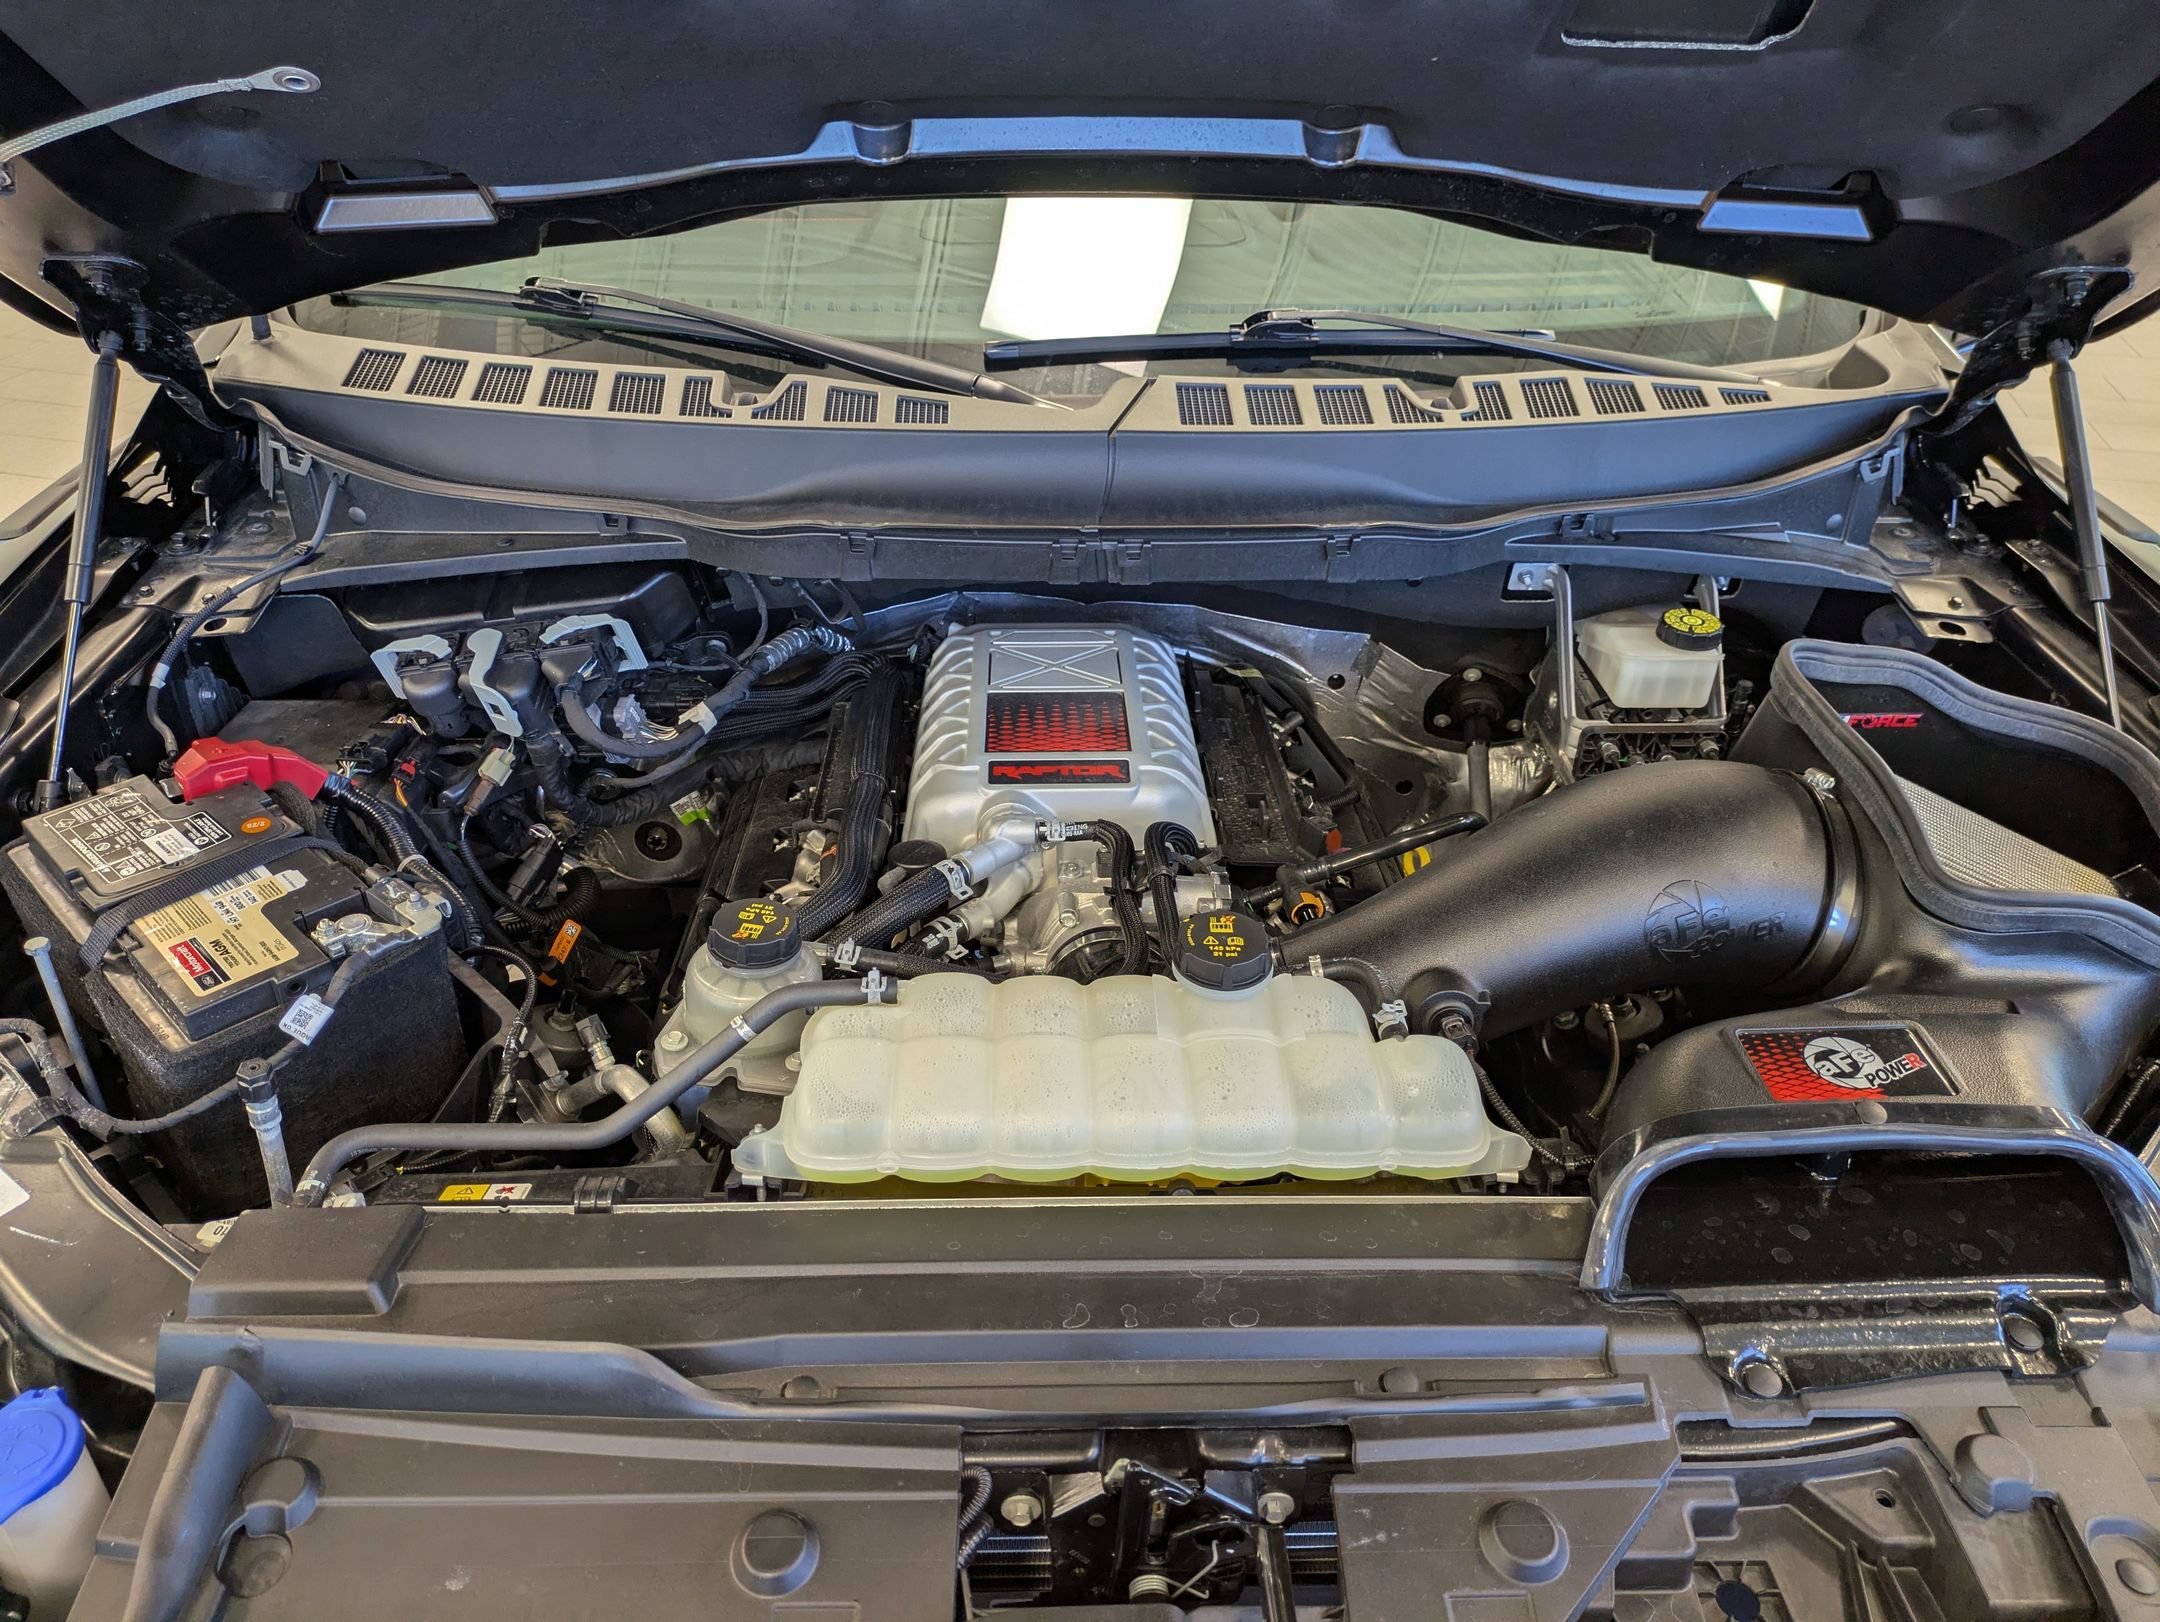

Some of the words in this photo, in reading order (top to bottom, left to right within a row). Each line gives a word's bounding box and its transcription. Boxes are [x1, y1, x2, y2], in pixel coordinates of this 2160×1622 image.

[992, 765, 1126, 780] RAPTOR
[246, 820, 266, 829] 2/25
[209, 938, 231, 957] AGM
[176, 944, 204, 973] Motorcraft
[1814, 1048, 1875, 1076] aFe
[1864, 1052, 1927, 1088] POWER
